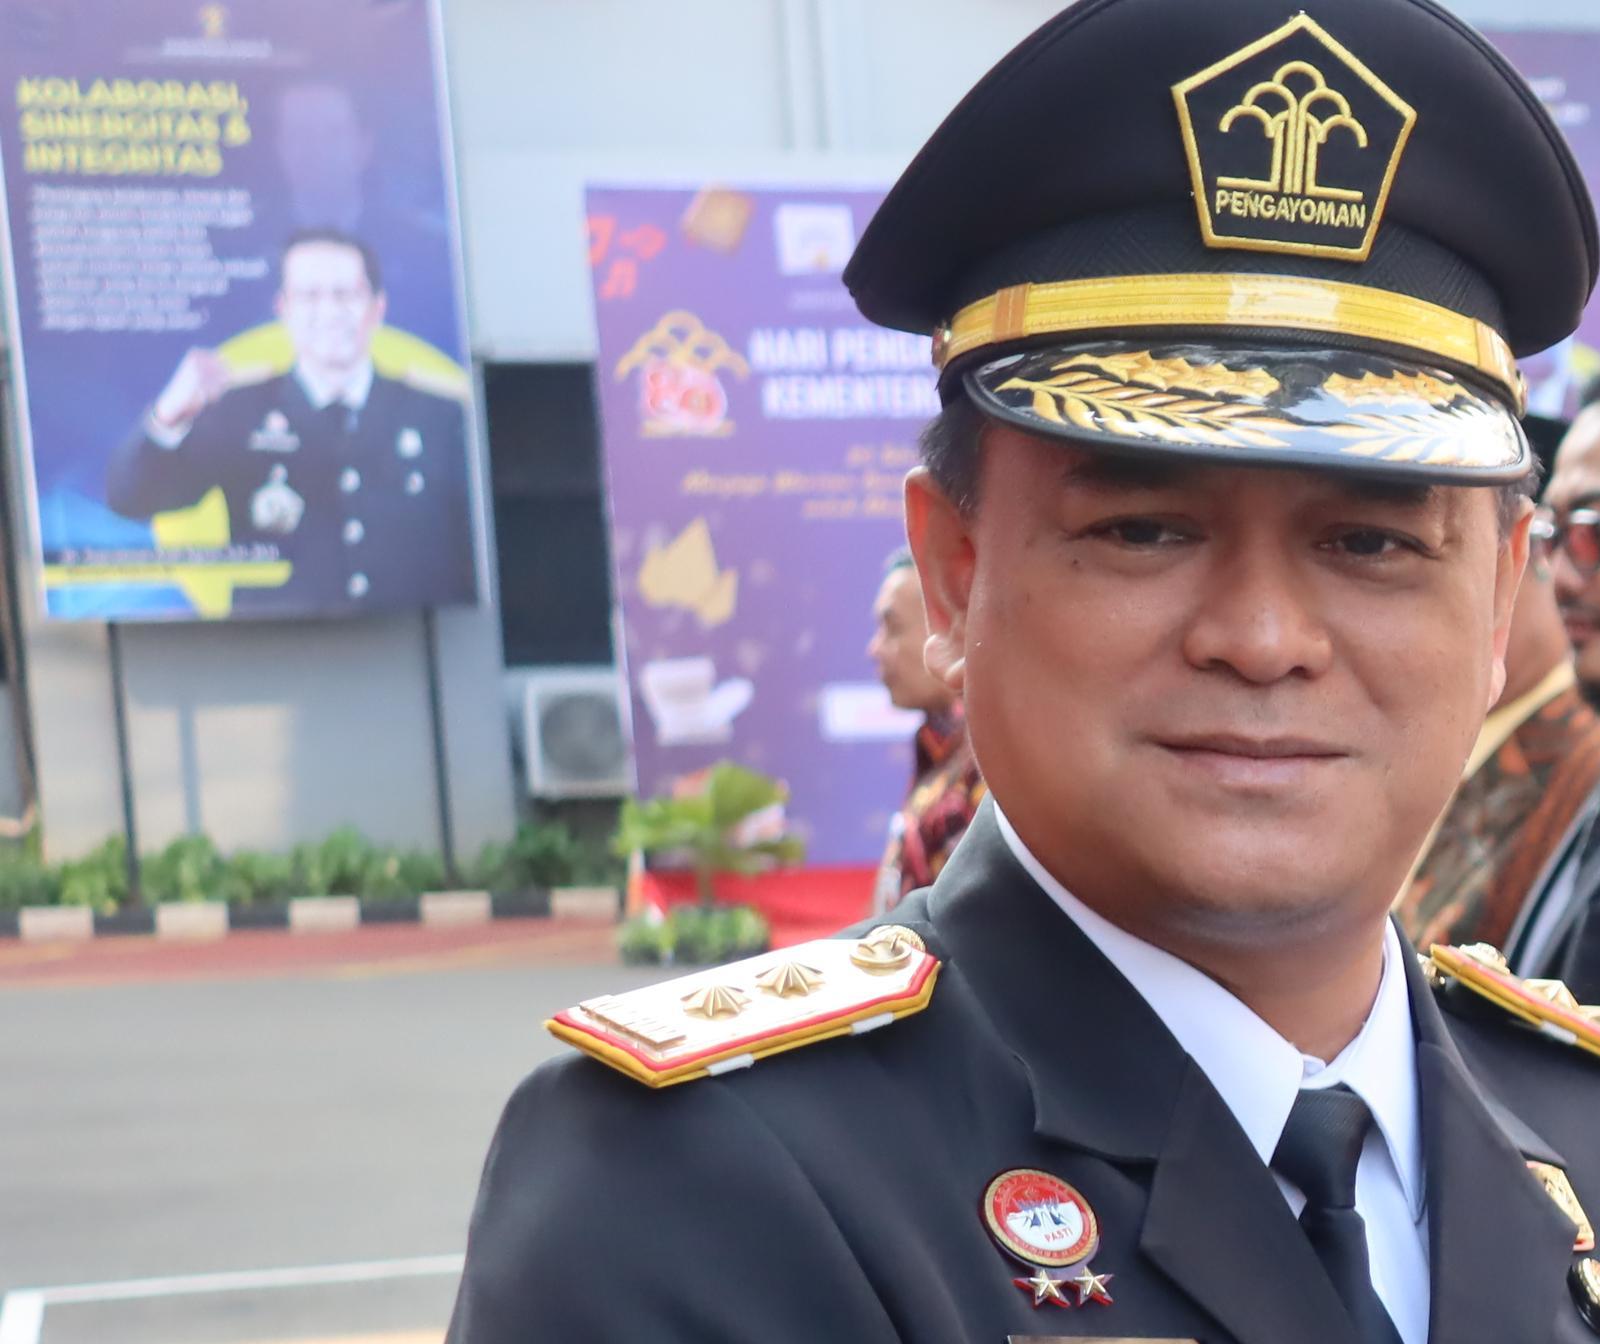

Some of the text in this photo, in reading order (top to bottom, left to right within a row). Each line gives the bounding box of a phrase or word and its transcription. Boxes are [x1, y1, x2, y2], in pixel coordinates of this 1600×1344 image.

[20, 110, 221, 143] SINERGITAS
[24, 143, 222, 176] INTEGRITAS
[1216, 190, 1366, 228] PENGAYOMAN
[750, 327, 828, 370] HARI
